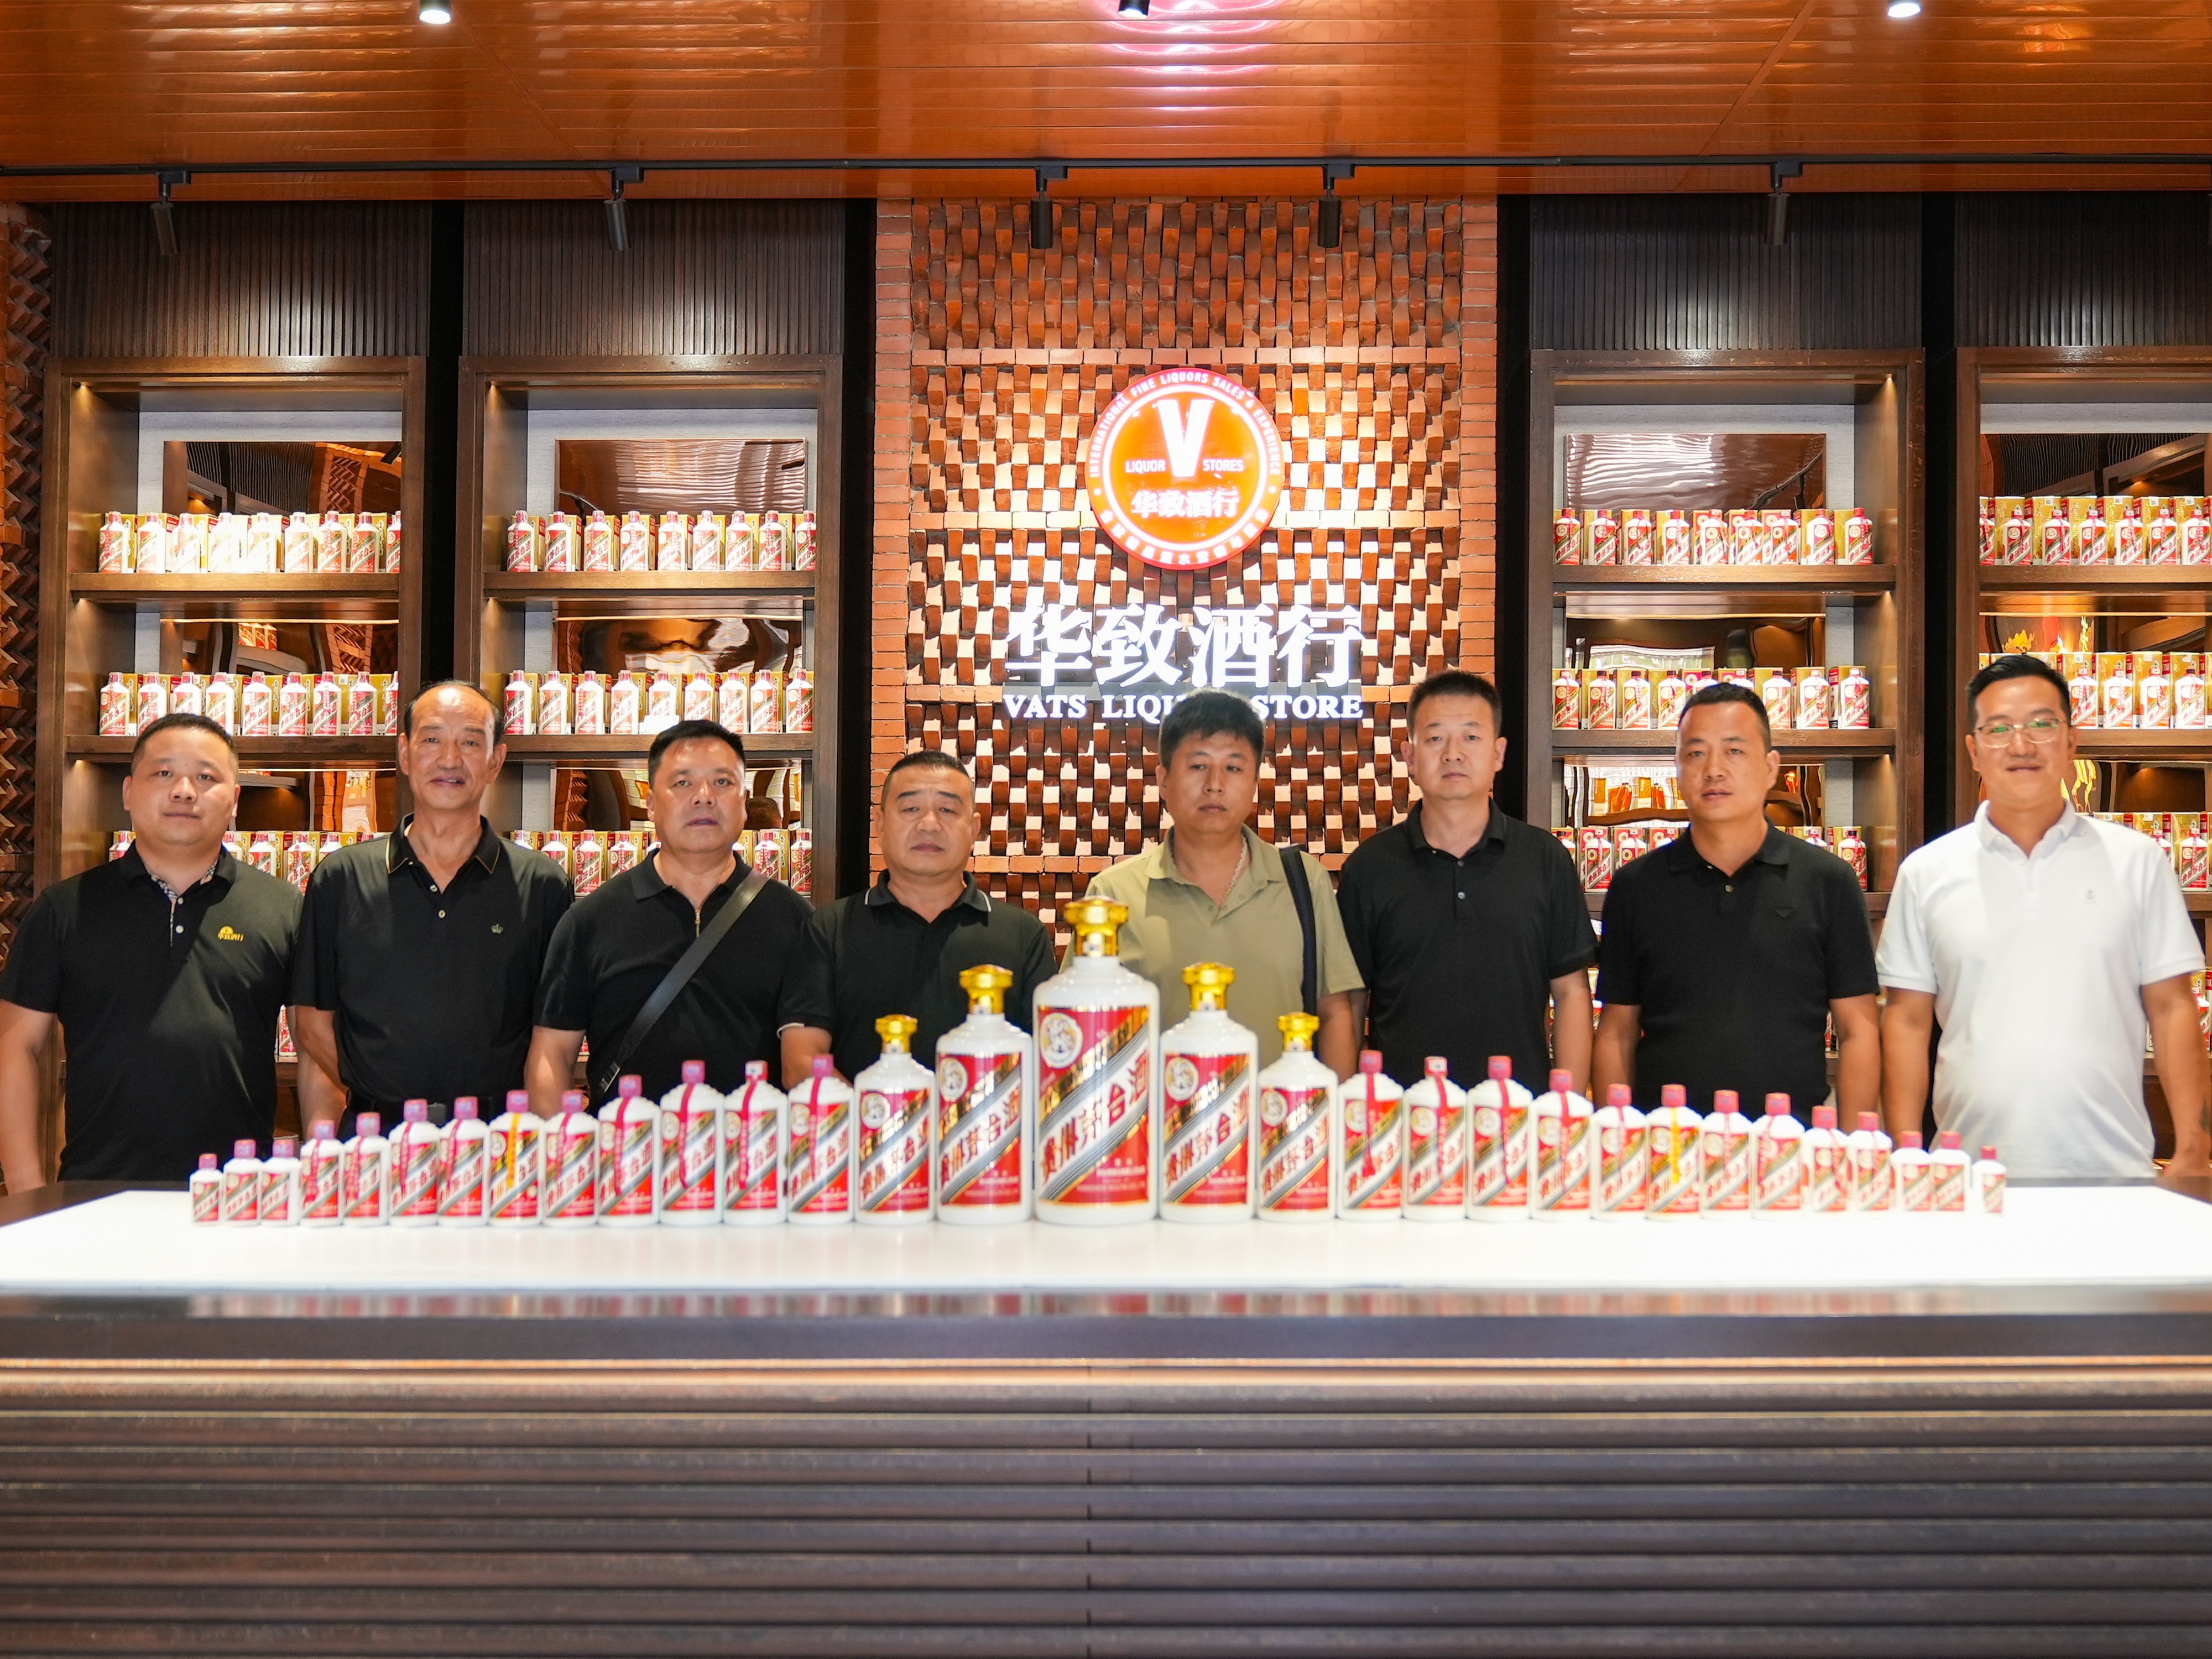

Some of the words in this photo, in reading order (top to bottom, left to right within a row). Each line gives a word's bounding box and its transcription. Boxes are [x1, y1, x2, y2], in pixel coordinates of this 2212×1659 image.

[1089, 394, 1130, 477] INTERNATIONAL
[1130, 378, 1156, 398] FINE
[1160, 372, 1209, 384] LIQUORS
[1213, 377, 1245, 400] SALES
[1253, 409, 1281, 476] EXPERIENCE
[1157, 399, 1214, 477] V
[1125, 460, 1166, 473] LIQUOR
[1202, 459, 1244, 472] STORES
[1131, 489, 1239, 519] 华致酒行
[1004, 603, 1365, 687] 华致酒行
[1003, 695, 1087, 718] VATS
[1102, 695, 1187, 724] LIQU
[1251, 695, 1363, 718] STORE
